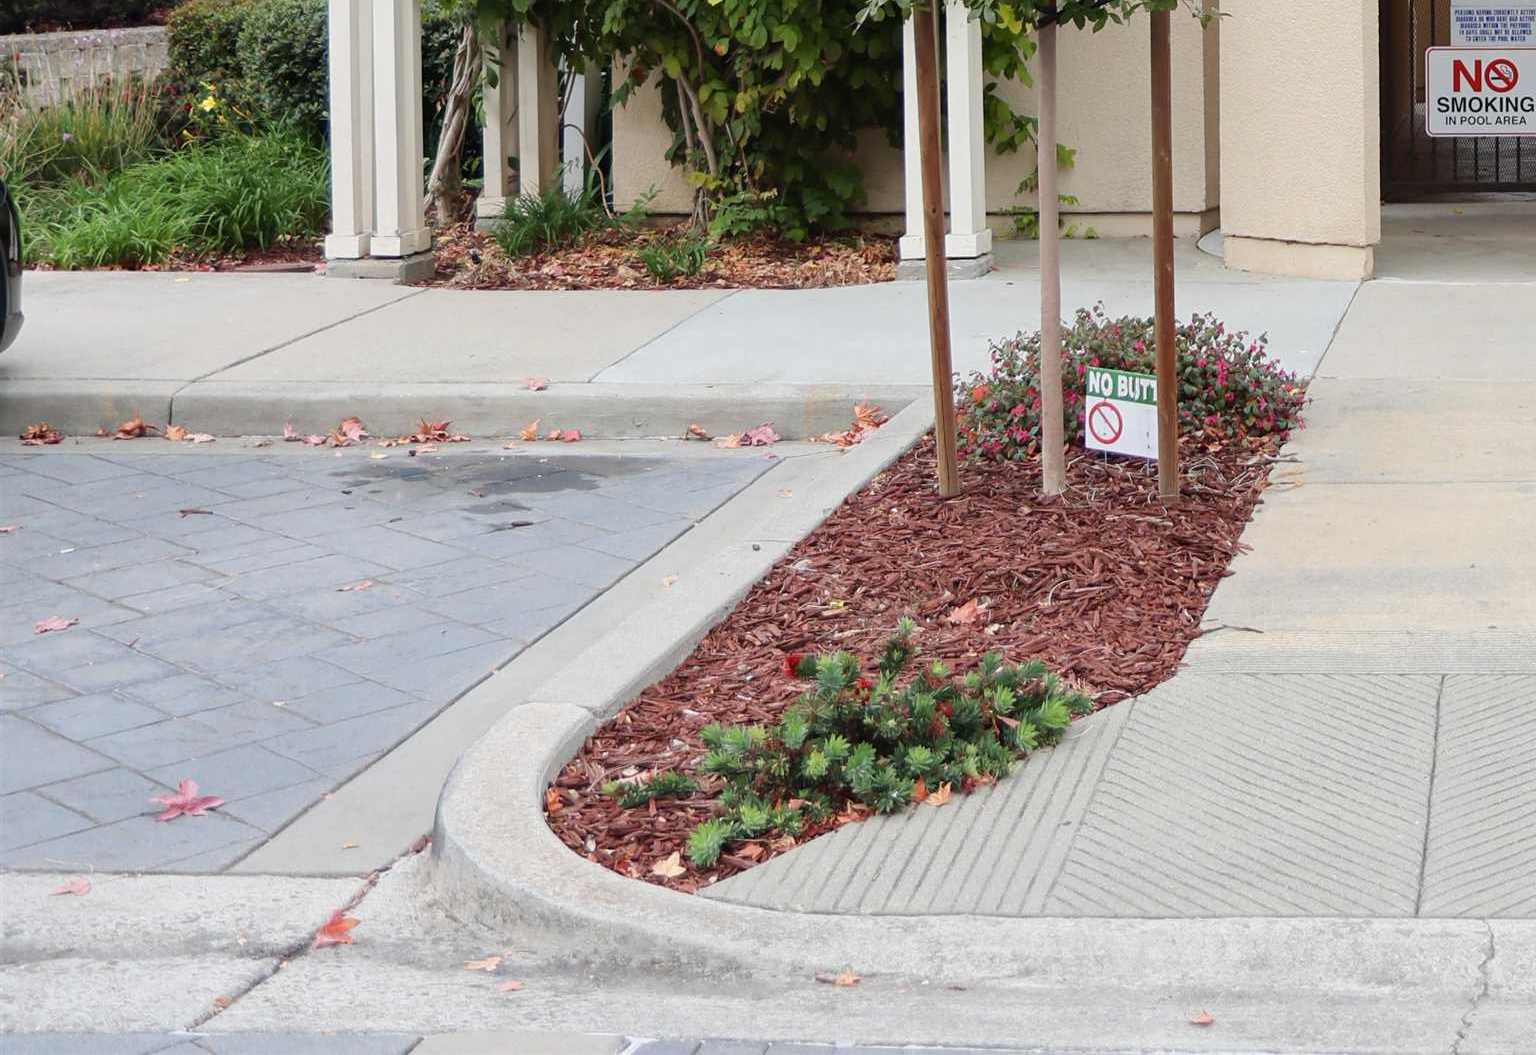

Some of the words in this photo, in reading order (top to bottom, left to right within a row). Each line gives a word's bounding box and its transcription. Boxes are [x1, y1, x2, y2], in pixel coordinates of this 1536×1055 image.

[1437, 96, 1535, 113] SMOKING
[1445, 116, 1457, 125] IN
[1460, 116, 1492, 125] POOL
[1495, 116, 1527, 125] AREA
[1088, 370, 1114, 396] NO
